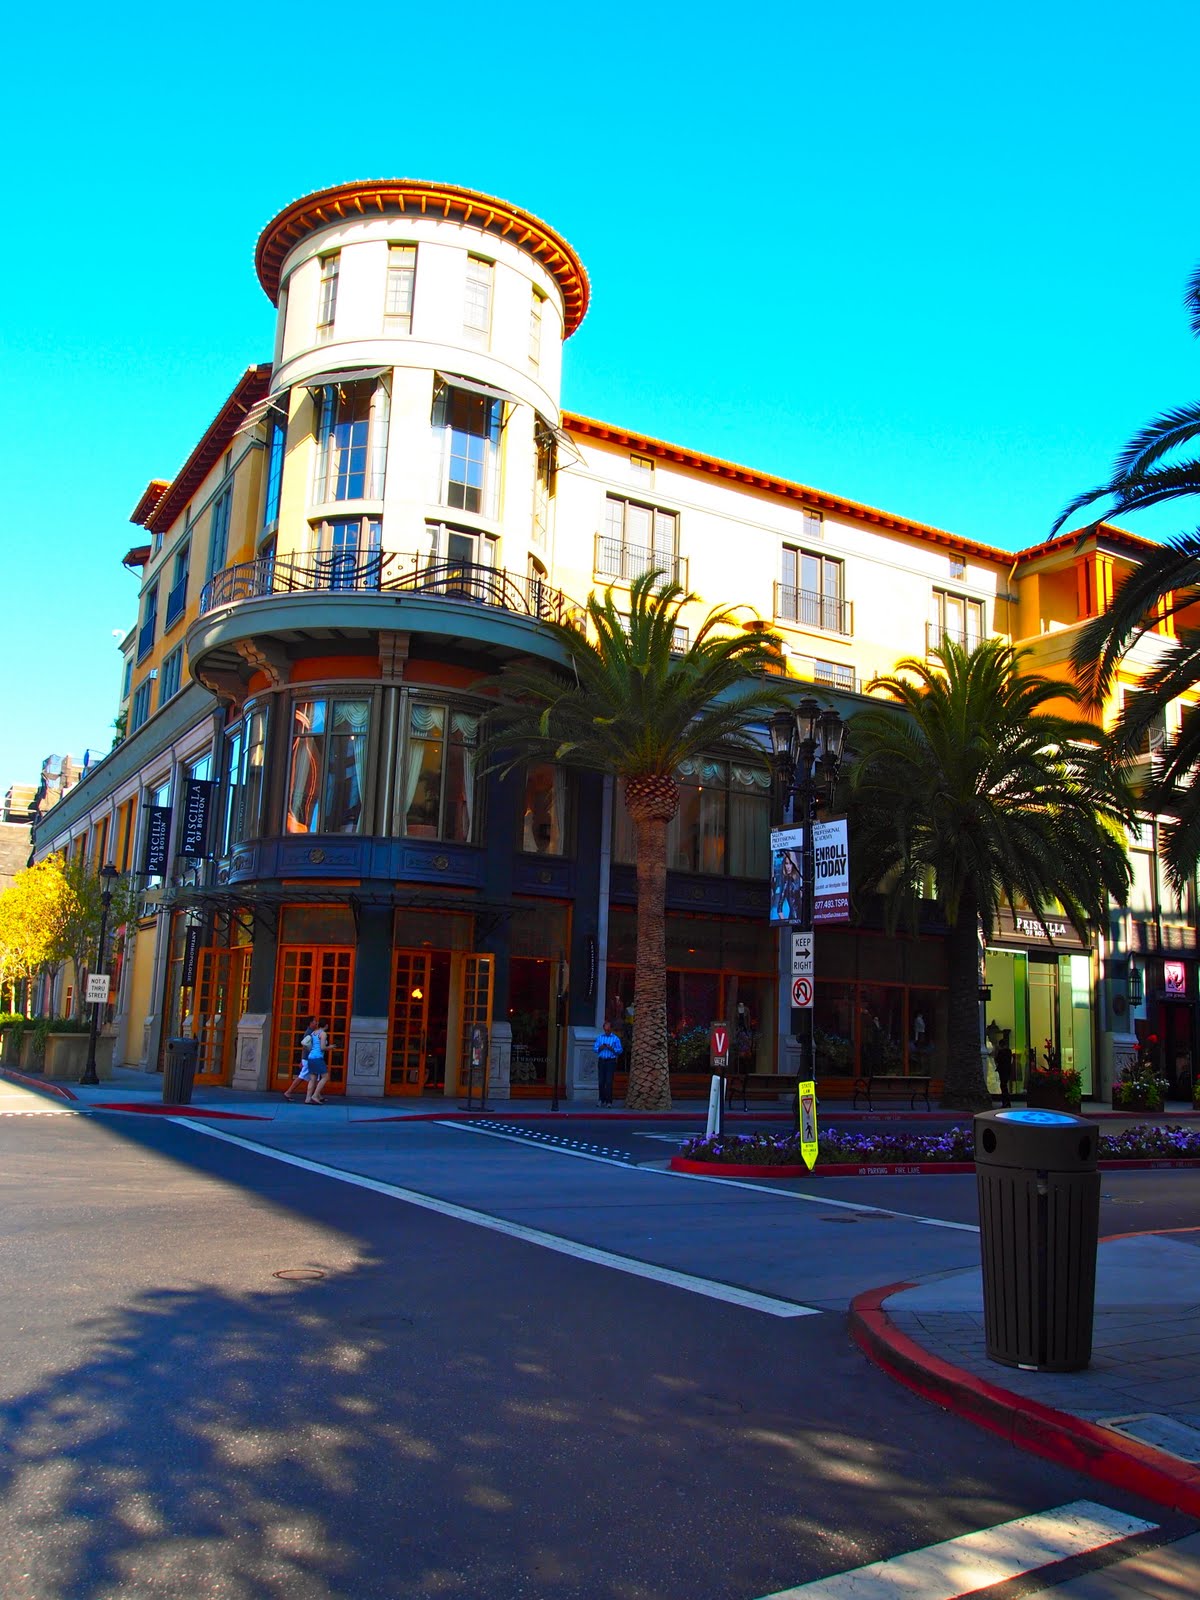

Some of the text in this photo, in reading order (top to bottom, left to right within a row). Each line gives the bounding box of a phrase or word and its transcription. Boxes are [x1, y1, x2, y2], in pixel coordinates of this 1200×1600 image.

[185, 785, 201, 852] PRISCILLA
[196, 797, 205, 841] OF BOSTON
[149, 811, 162, 871] PRISCILLA
[815, 844, 847, 861] ENROLL
[815, 859, 847, 878] TODAY
[795, 938, 811, 947] KEEP
[793, 961, 812, 970] RIGHT
[715, 1032, 725, 1053] V
[895, 1166, 906, 1174] FIRE
[907, 1166, 921, 1174] LANE
